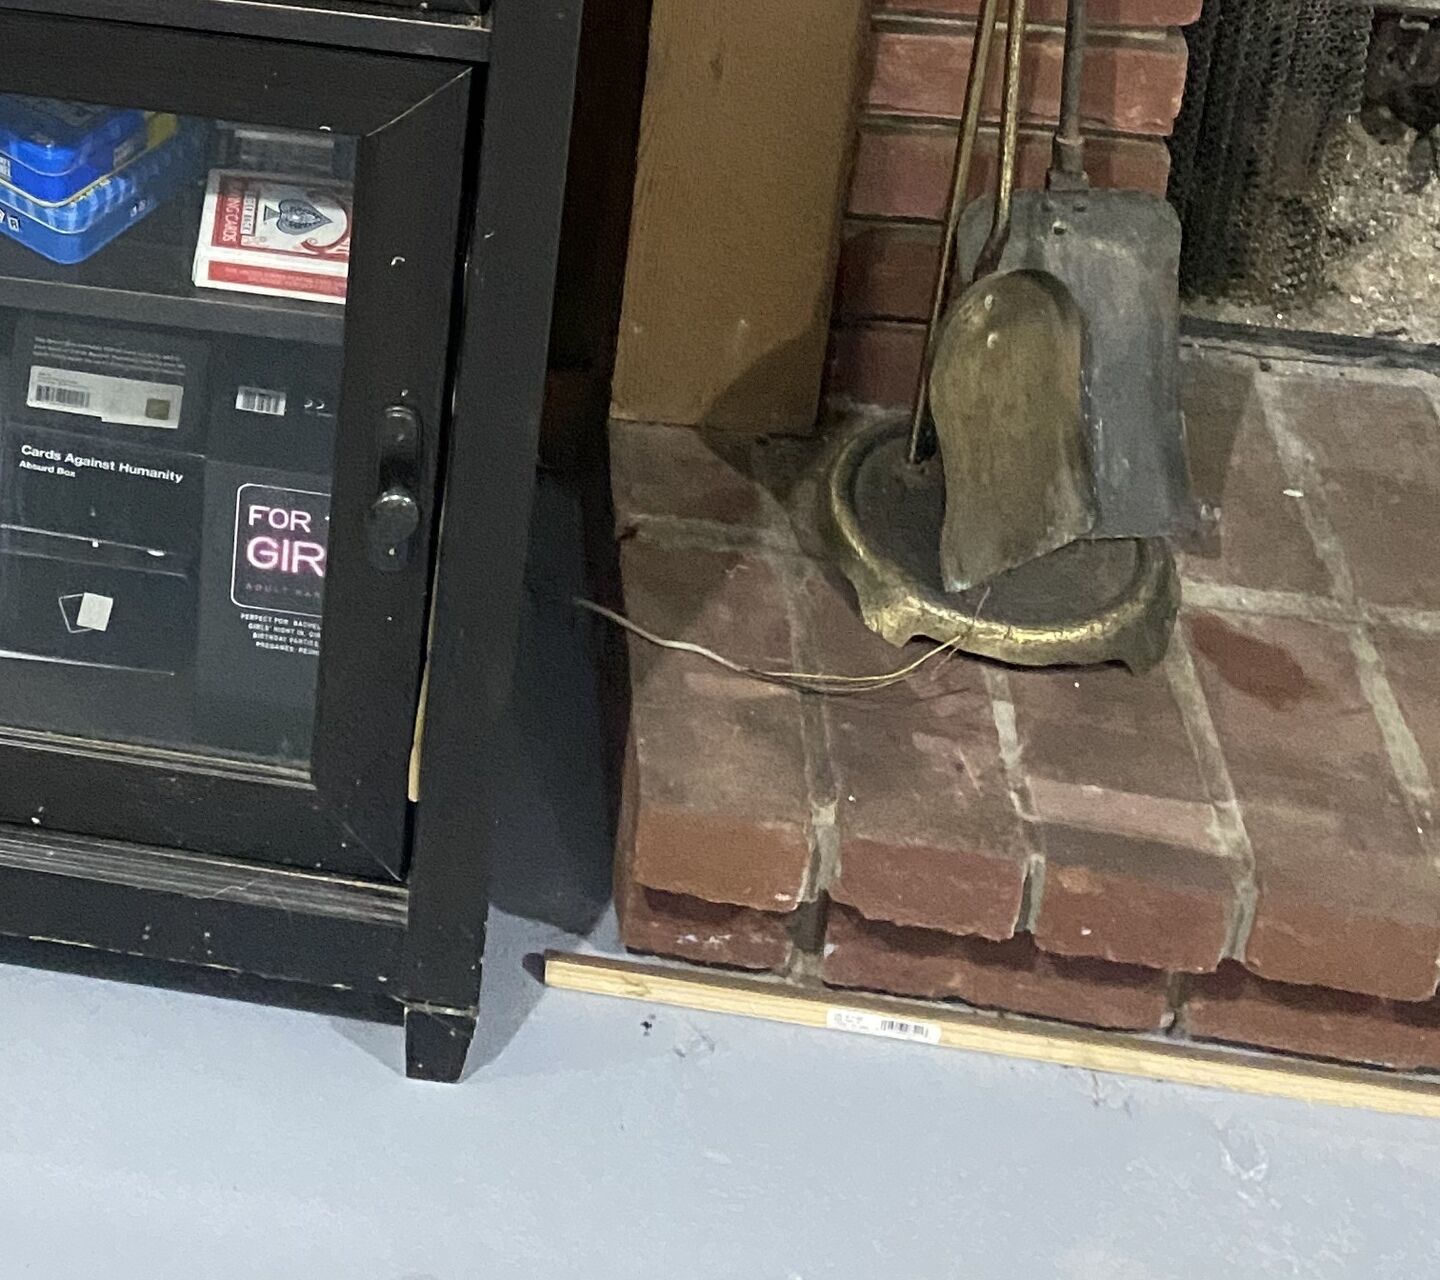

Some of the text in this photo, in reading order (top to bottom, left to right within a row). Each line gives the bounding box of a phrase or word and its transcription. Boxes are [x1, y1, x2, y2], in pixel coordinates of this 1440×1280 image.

[19, 460, 76, 478] Absurd Box
[21, 444, 184, 484] Cards Against Humanity
[247, 503, 312, 533] FOR
[246, 536, 326, 578] GIR
